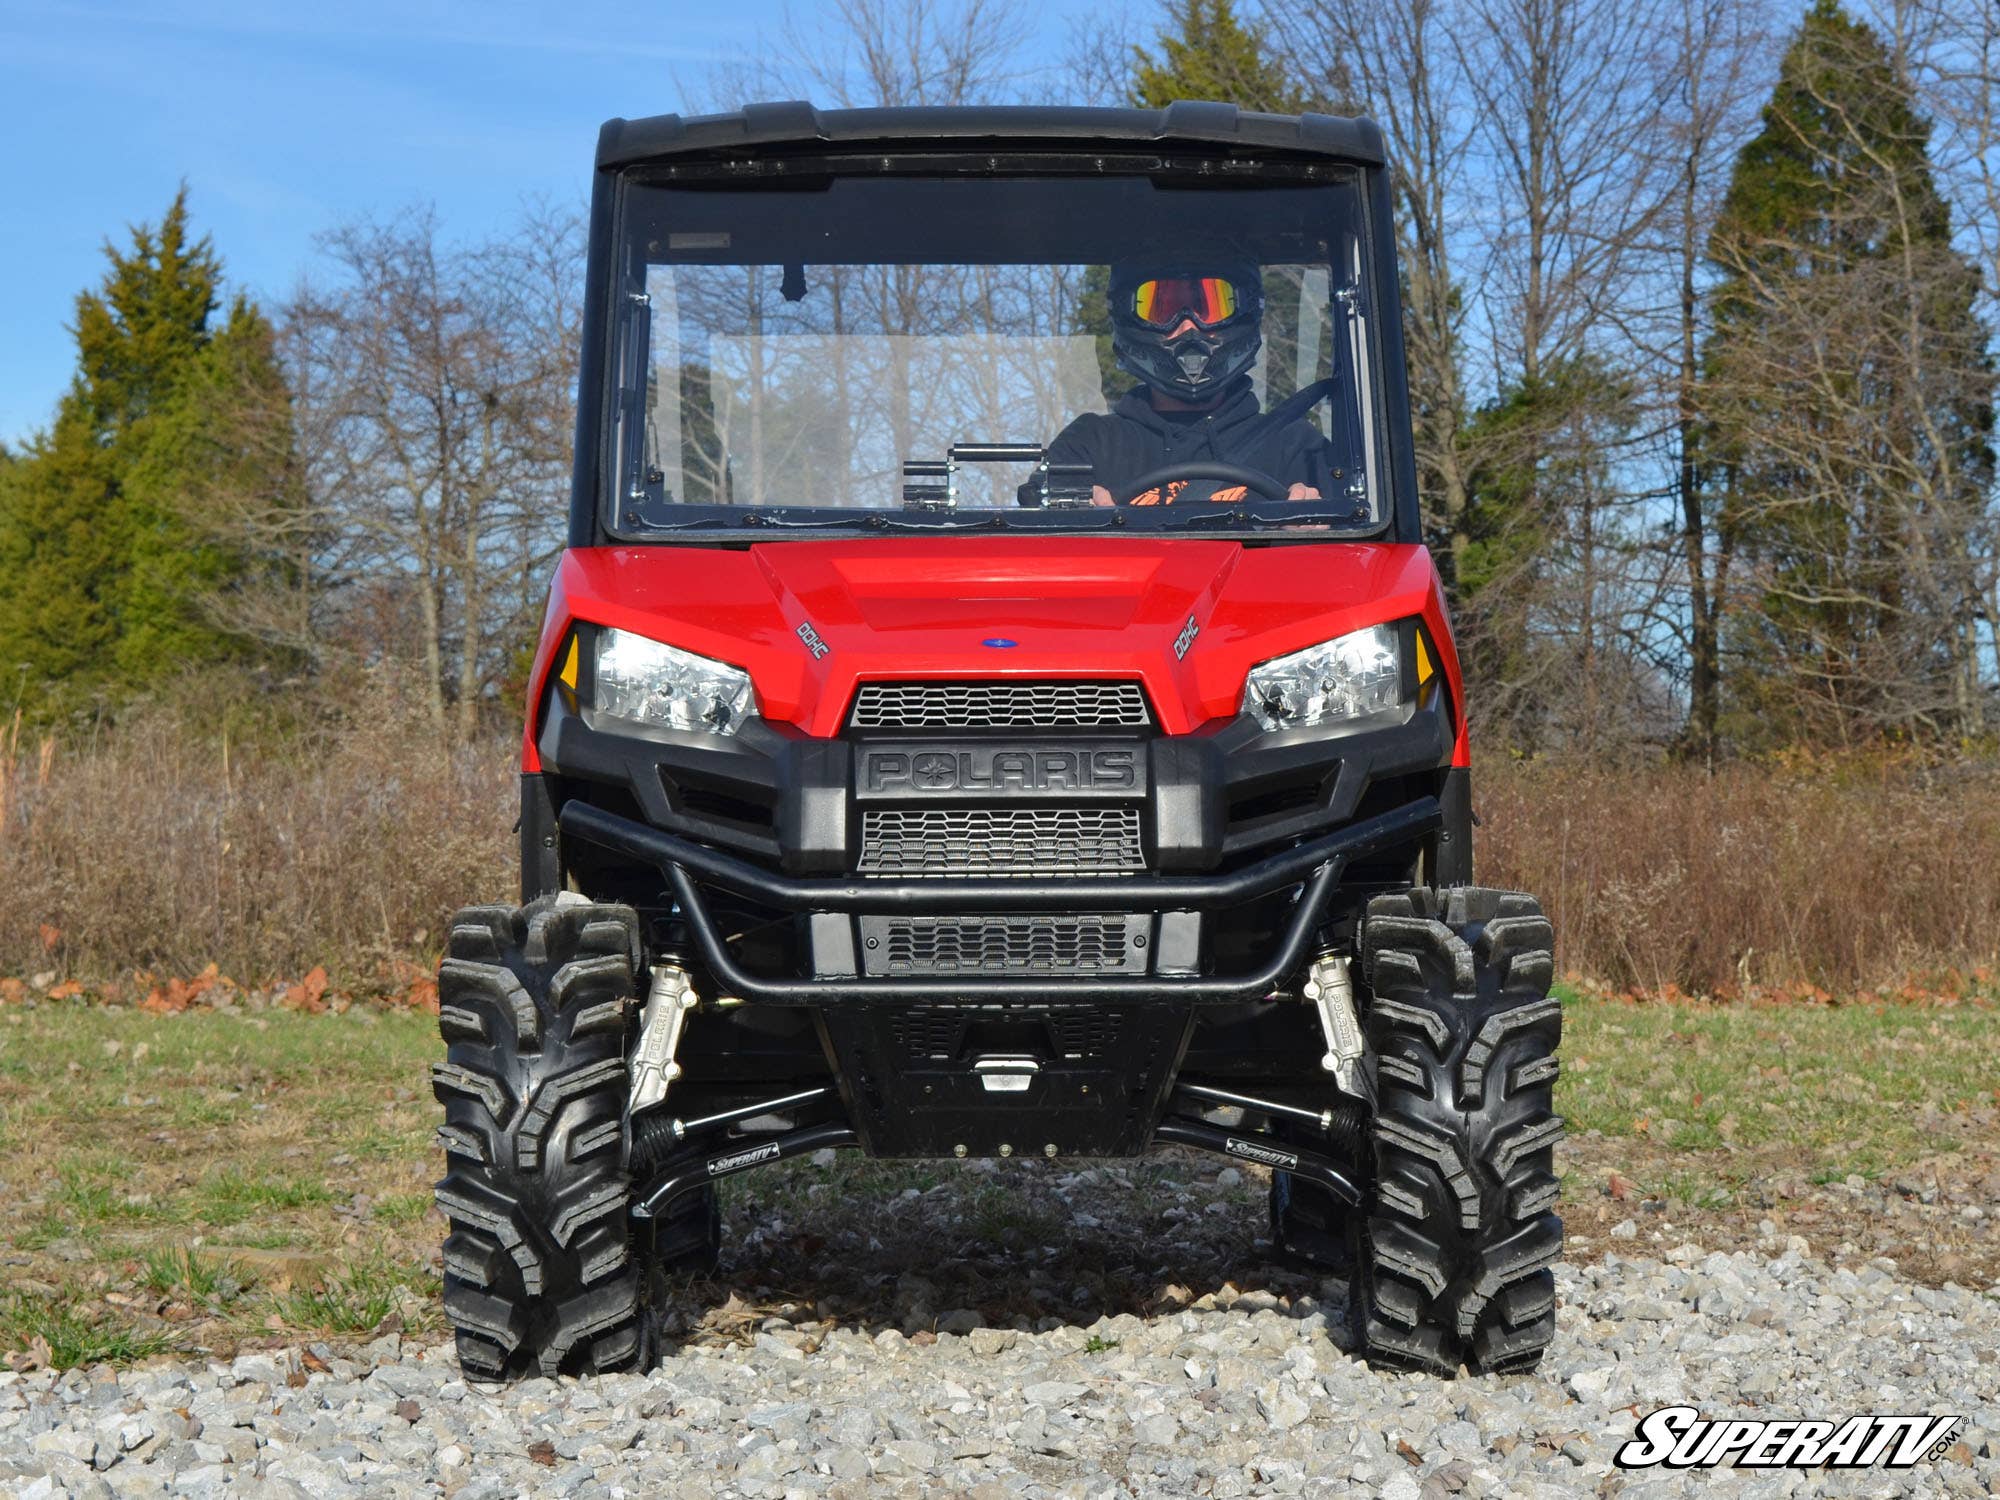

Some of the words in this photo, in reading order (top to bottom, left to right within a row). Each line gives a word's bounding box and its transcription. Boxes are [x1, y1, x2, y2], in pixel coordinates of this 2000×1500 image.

[867, 751, 1135, 790] POLARIS
[1331, 993, 1353, 1048] POLARIS
[714, 1147, 772, 1171] SUPERATV
